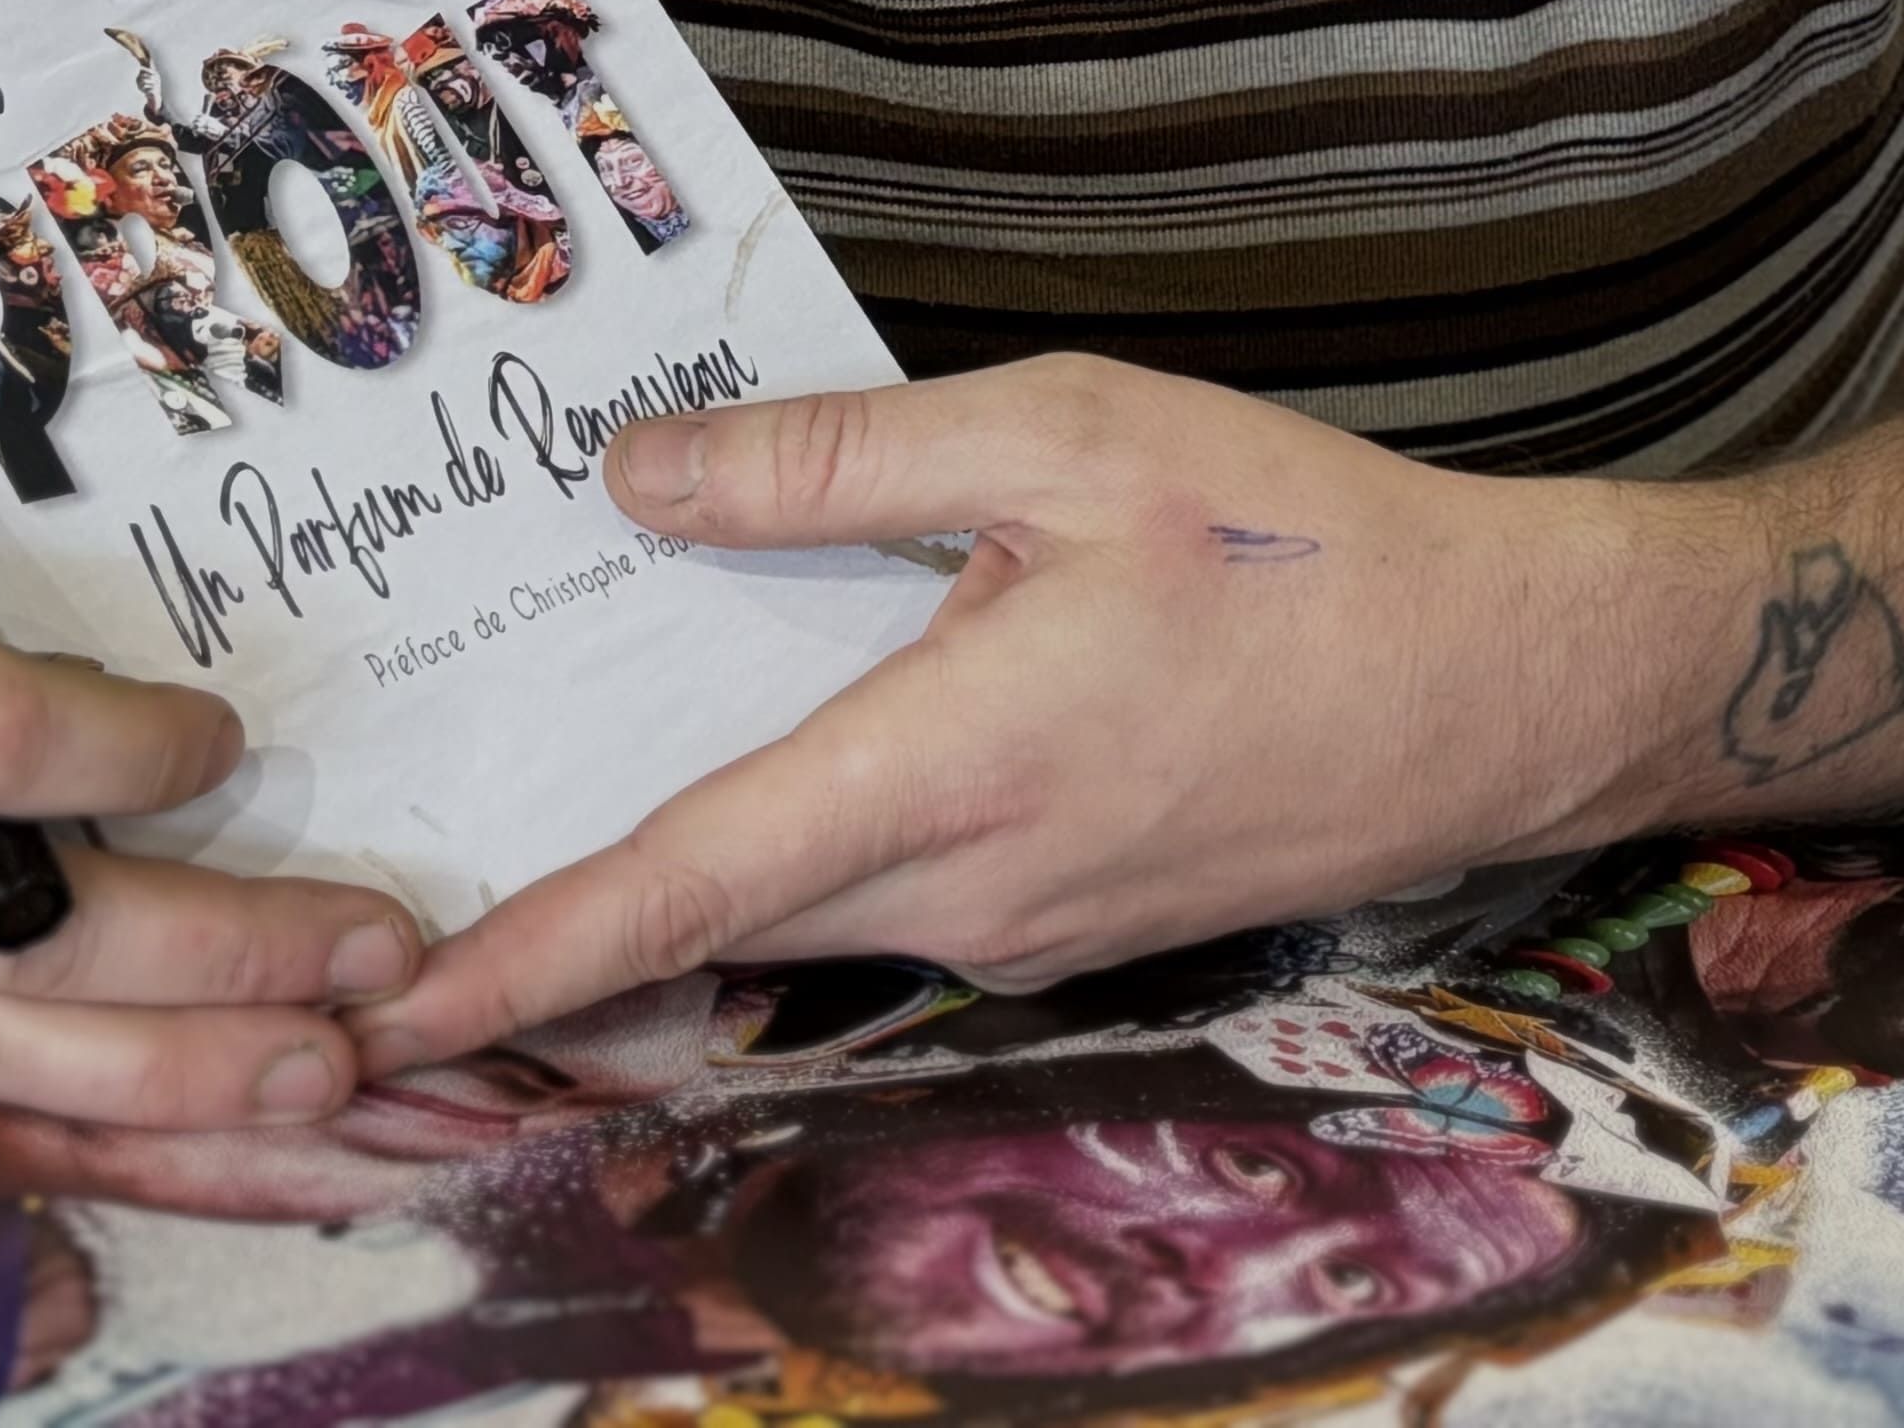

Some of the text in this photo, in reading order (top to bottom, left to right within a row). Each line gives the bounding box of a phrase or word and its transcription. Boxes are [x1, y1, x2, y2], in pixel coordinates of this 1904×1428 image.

[129, 503, 244, 668] Un
[219, 461, 443, 619] Parfum
[430, 391, 504, 506] de
[364, 628, 465, 688] Préface
[472, 608, 507, 642] de
[509, 549, 638, 621] Christophe
